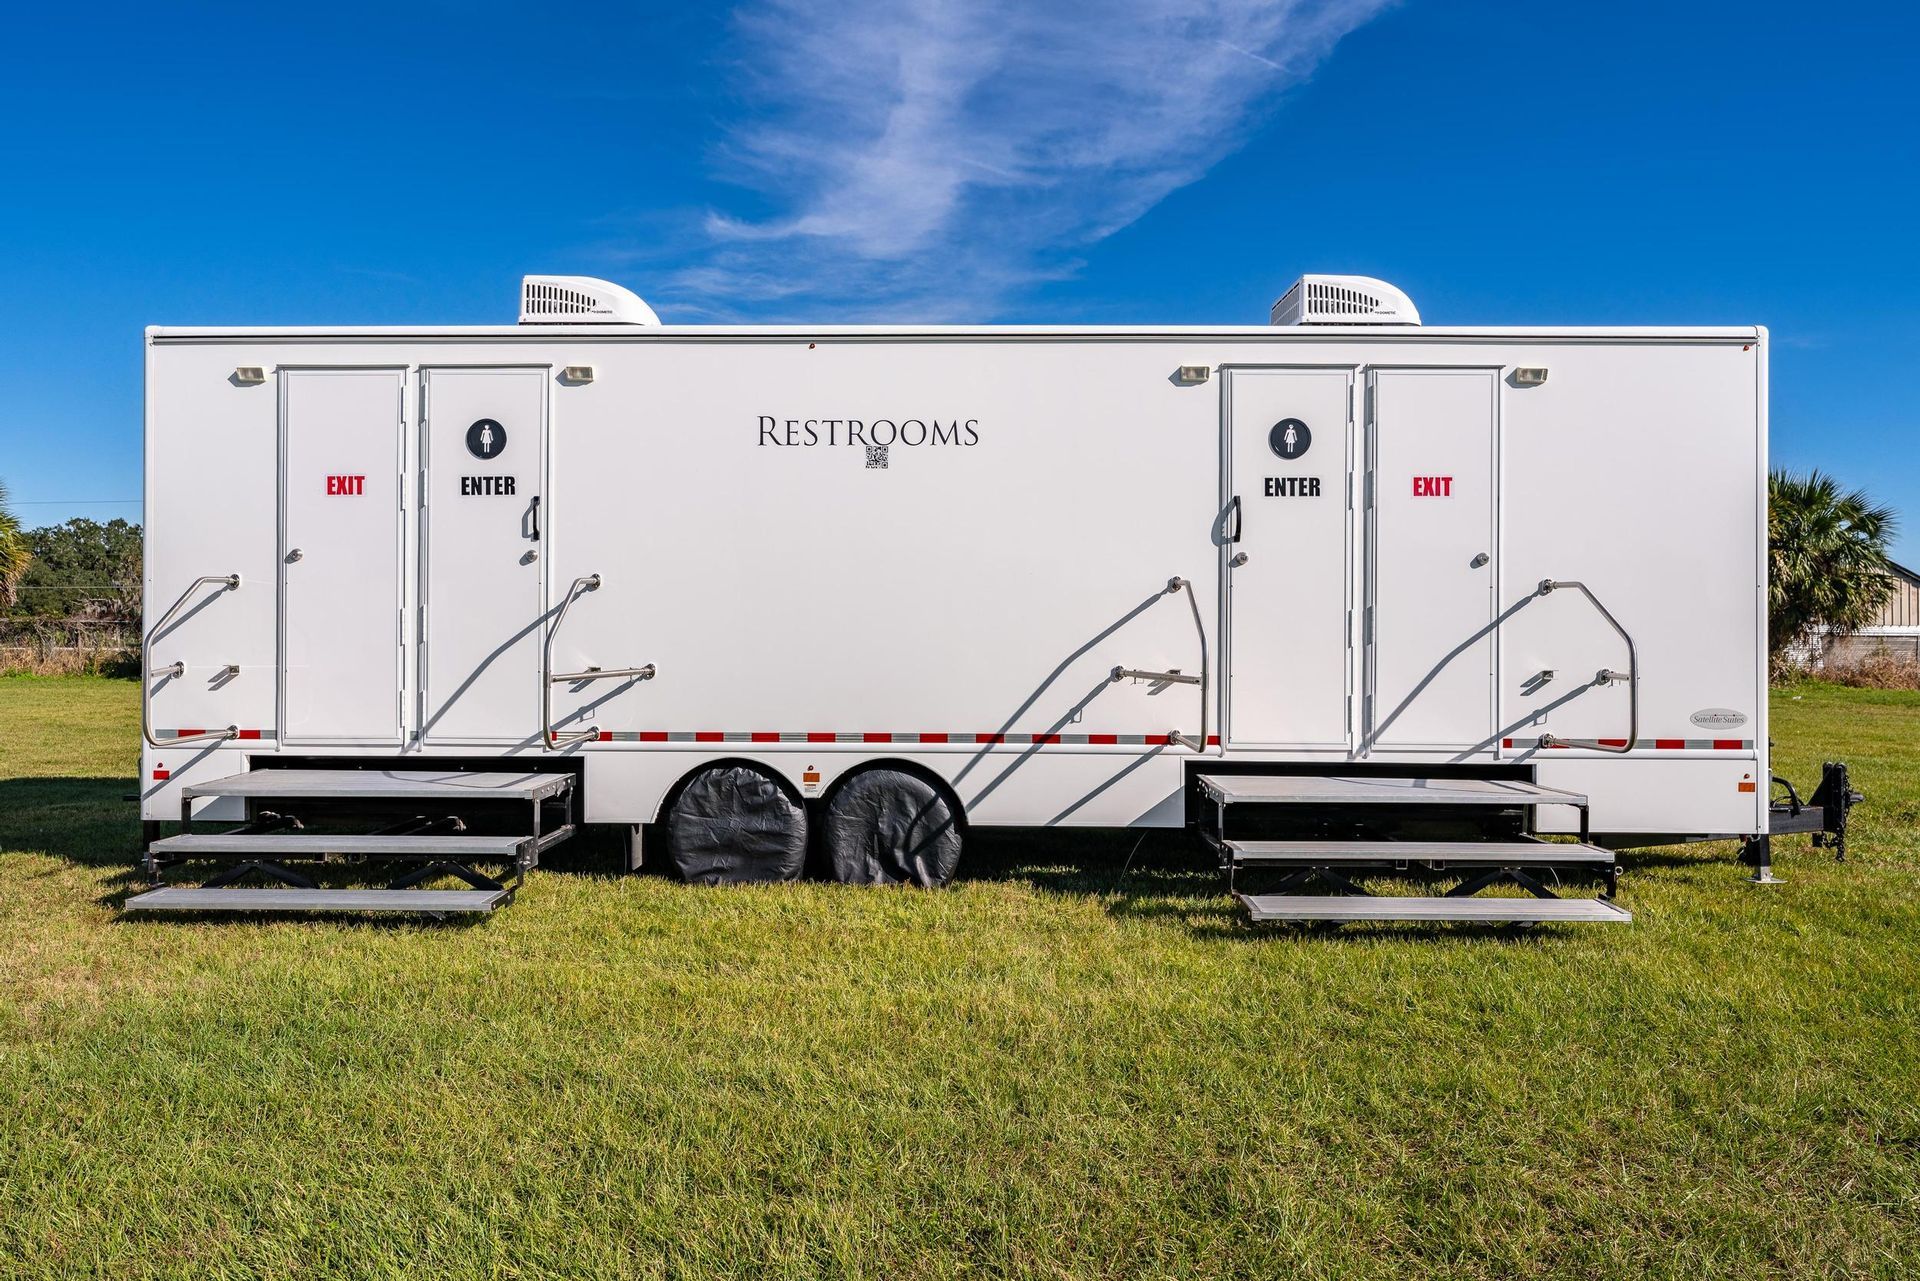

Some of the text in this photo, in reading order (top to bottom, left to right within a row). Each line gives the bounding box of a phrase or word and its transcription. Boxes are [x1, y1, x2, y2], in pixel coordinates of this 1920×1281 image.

[326, 475, 365, 496] EXIT
[460, 475, 516, 496] ENTER
[1264, 477, 1321, 497] ENTER
[1413, 476, 1453, 497] EXIT
[1694, 715, 1745, 724] Satellite Suites
